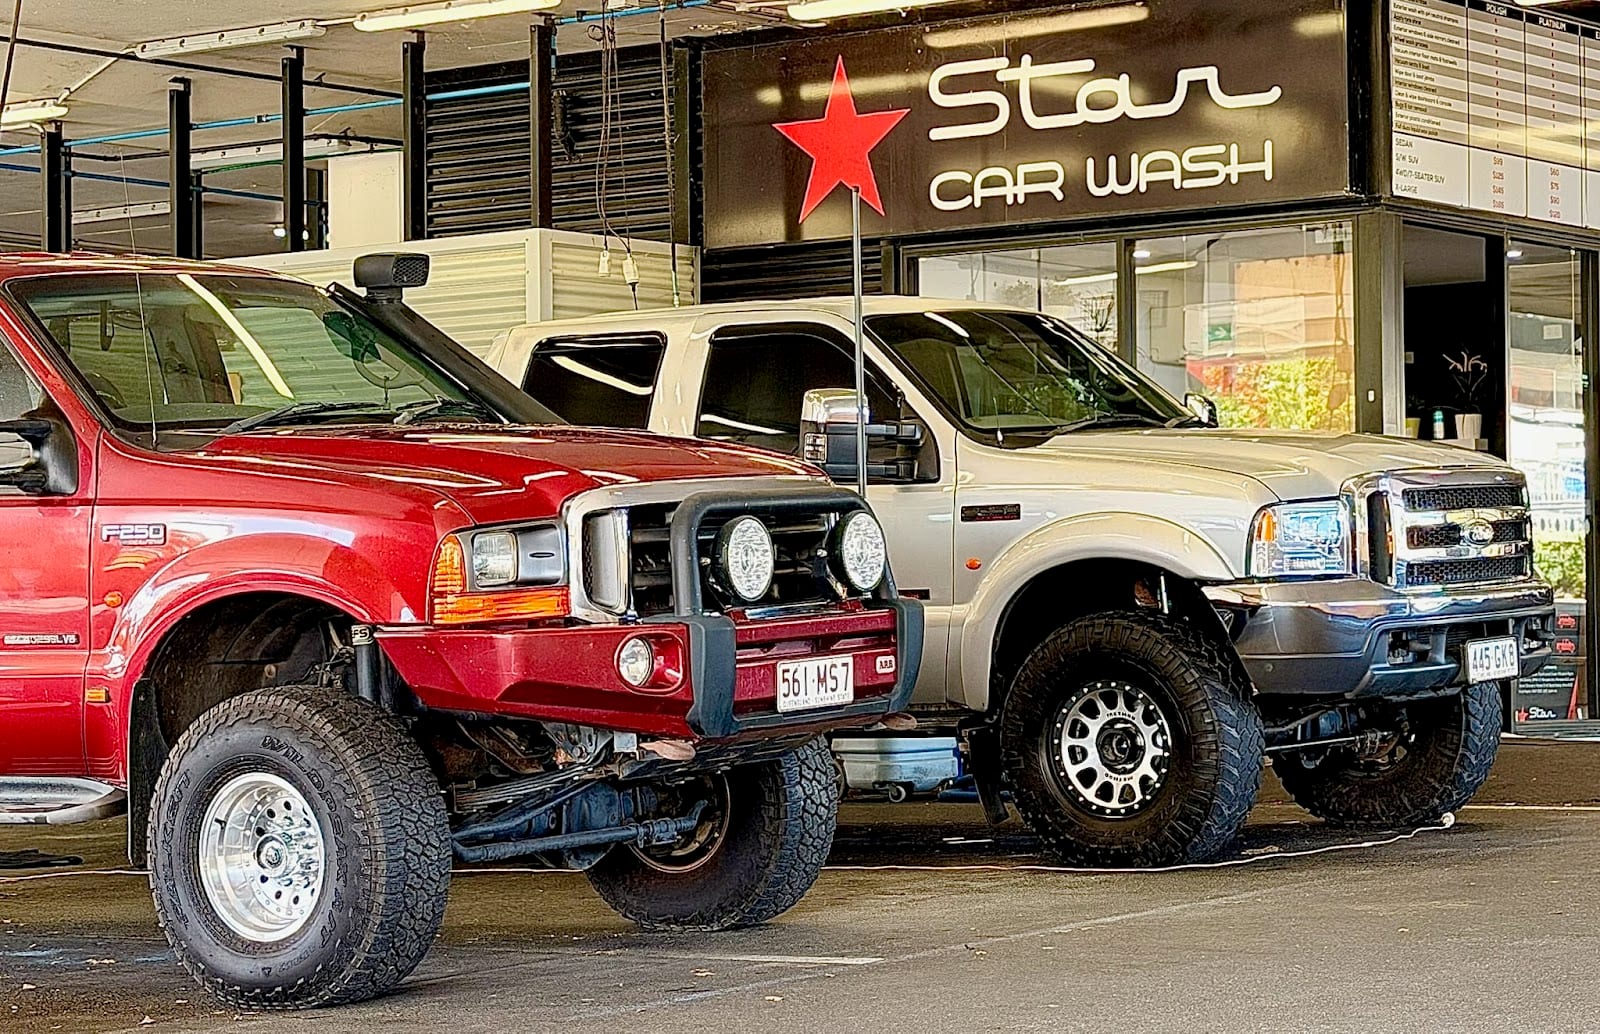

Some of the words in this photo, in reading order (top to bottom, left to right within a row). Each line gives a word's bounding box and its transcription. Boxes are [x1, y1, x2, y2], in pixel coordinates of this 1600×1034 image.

[1486, 3, 1507, 16] POLISH
[1538, 17, 1567, 31] PLATINUM
[928, 53, 1282, 141] Star
[929, 161, 1065, 211] CAR
[1086, 139, 1274, 197] WASH
[101, 523, 165, 543] F250
[1529, 706, 1557, 719] Star
